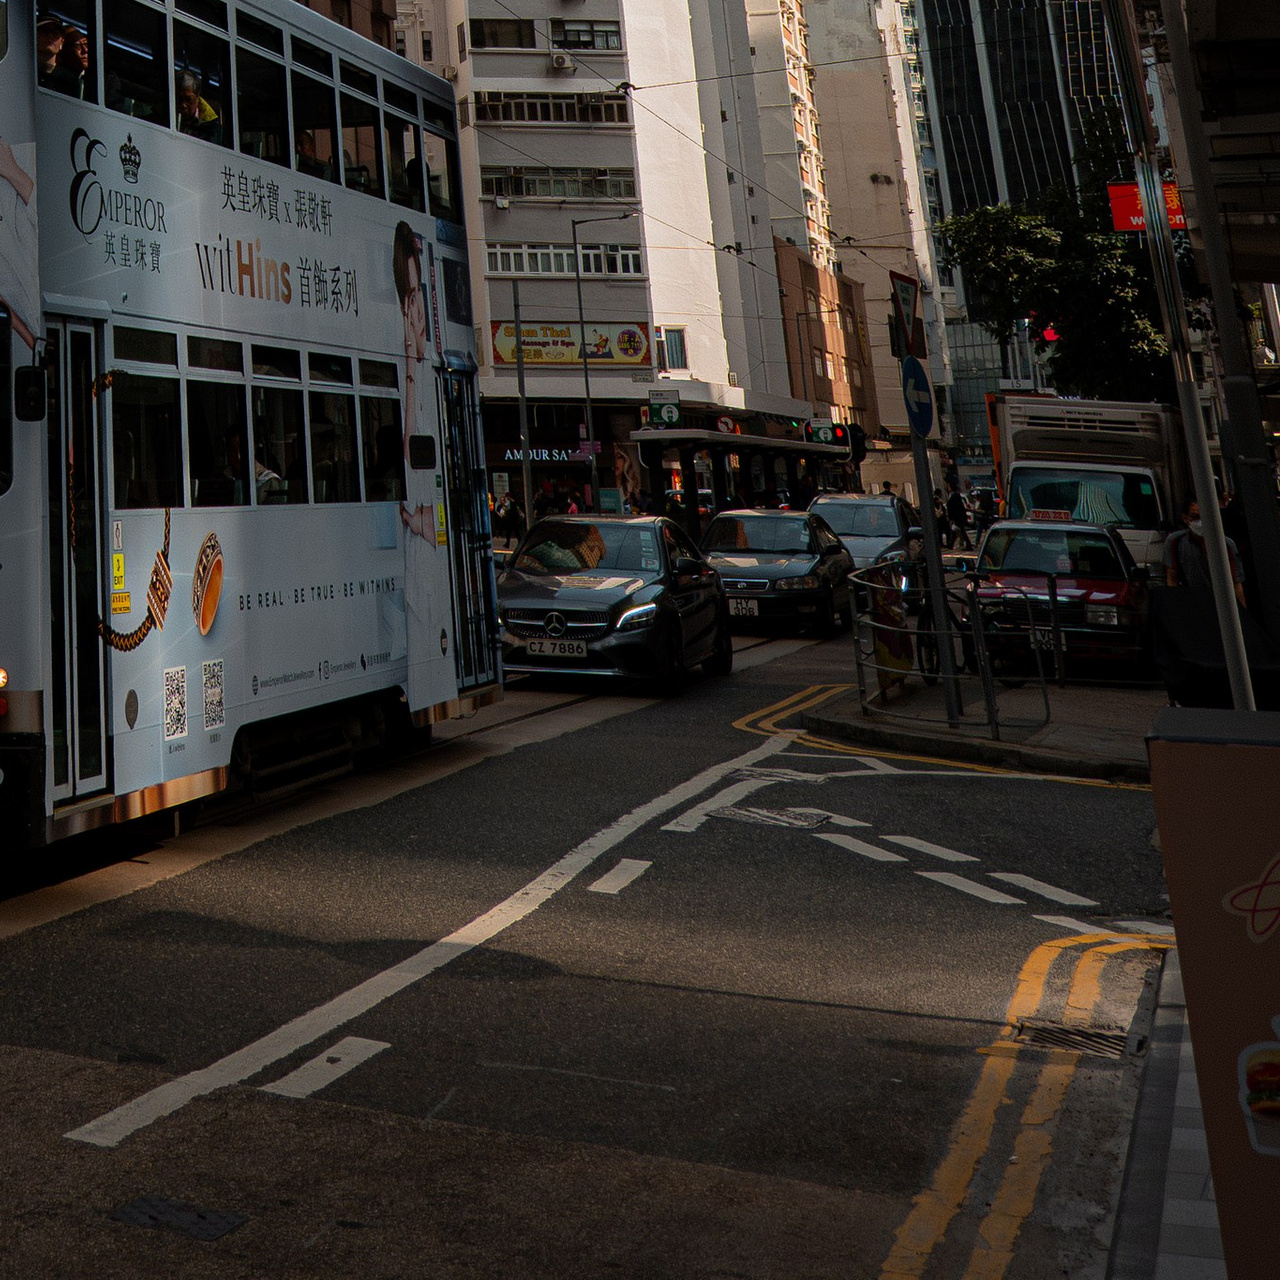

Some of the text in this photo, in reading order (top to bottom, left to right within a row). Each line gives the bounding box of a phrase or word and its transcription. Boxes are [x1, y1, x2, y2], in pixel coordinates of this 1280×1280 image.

[220, 165, 280, 224] 英皇珠寶
[293, 189, 333, 237] 張敬軒
[103, 230, 161, 274] 英皇珠寶
[195, 233, 360, 318] witHins 首飾系列
[539, 326, 571, 338] Thai
[560, 339, 576, 348] Spa
[1032, 509, 1070, 521] TAXI
[240, 578, 395, 610] BE REAL BE TRUE BE WITHINS
[529, 642, 584, 655] CZ 7886
